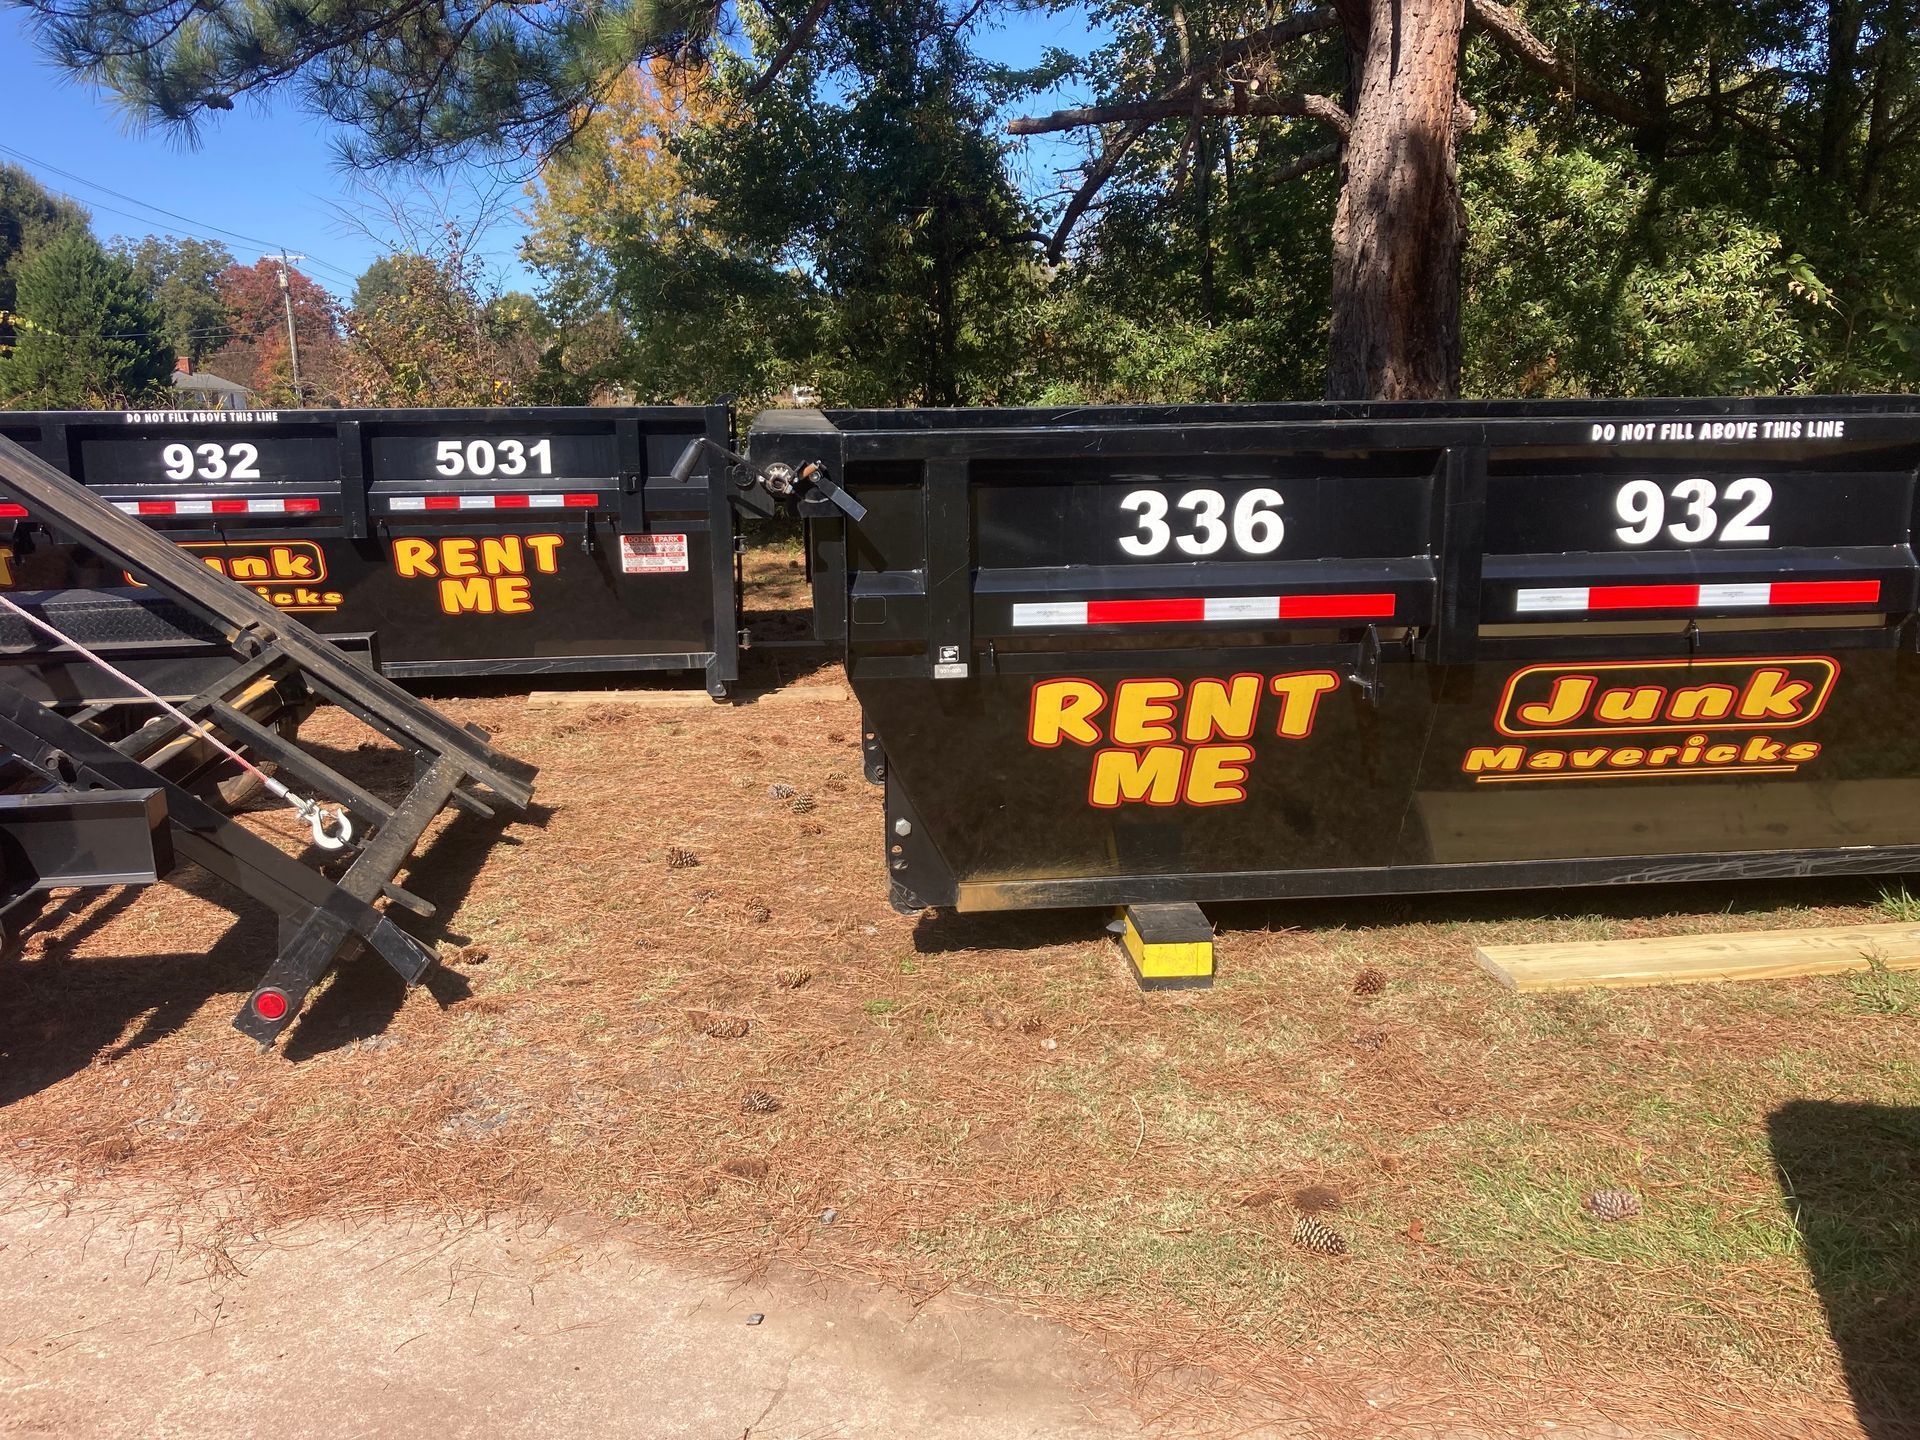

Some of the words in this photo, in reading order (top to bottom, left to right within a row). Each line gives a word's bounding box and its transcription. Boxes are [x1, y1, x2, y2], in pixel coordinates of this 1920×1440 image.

[127, 413, 141, 423] DO
[144, 413, 165, 423] NOT
[168, 413, 190, 422] FILL
[192, 413, 227, 422] ABOVE
[229, 412, 253, 422] THIS
[256, 412, 279, 421] LINE
[1591, 423, 1616, 441] DO
[1621, 423, 1656, 440] NOT
[1660, 423, 1695, 440] FILL
[1699, 422, 1758, 439] ABOVE
[1762, 421, 1802, 438] THIS
[1807, 421, 1845, 438] LINE
[163, 443, 261, 480] 932
[435, 439, 552, 476] 5031
[1118, 488, 1285, 556] 336
[1615, 477, 1774, 544] 932
[392, 534, 565, 578] RENT
[438, 575, 534, 615] ME
[1028, 670, 1341, 748] RENT
[1517, 668, 1813, 726] Junk
[1462, 734, 1822, 773] Mavericks
[1088, 743, 1256, 808] ME
